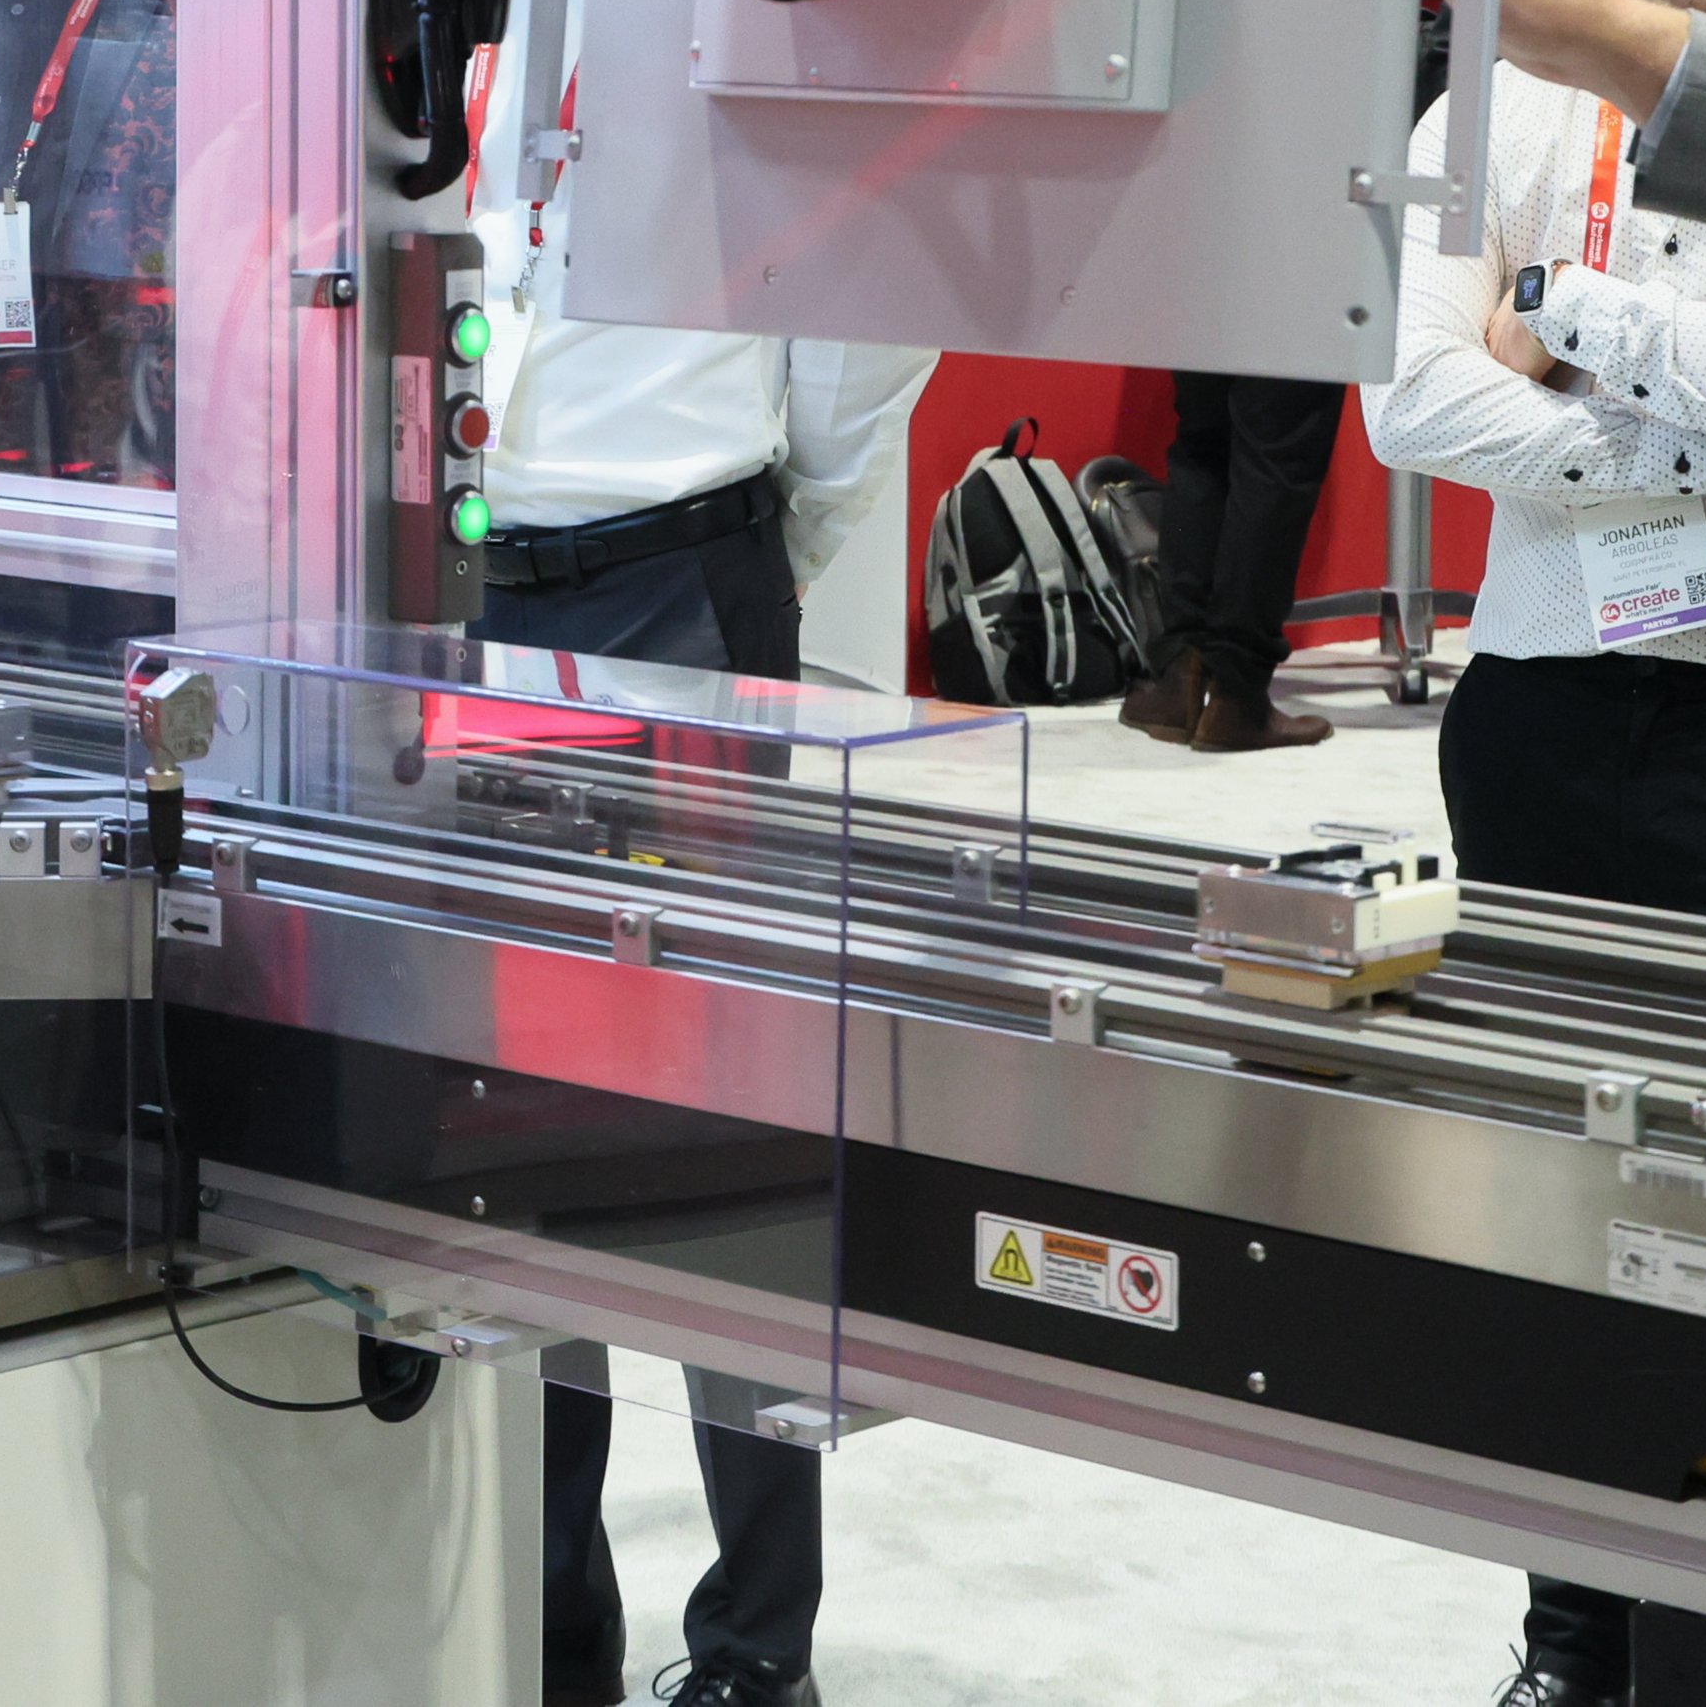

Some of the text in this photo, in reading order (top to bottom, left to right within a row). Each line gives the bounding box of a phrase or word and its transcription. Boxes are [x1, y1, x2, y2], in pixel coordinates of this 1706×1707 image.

[1593, 222, 1606, 264] Rockwell
[1598, 514, 1685, 547] JONATHAN
[1611, 534, 1679, 559] ARBOLEAS
[1603, 586, 1645, 602] Automation
[1622, 588, 1681, 612] create
